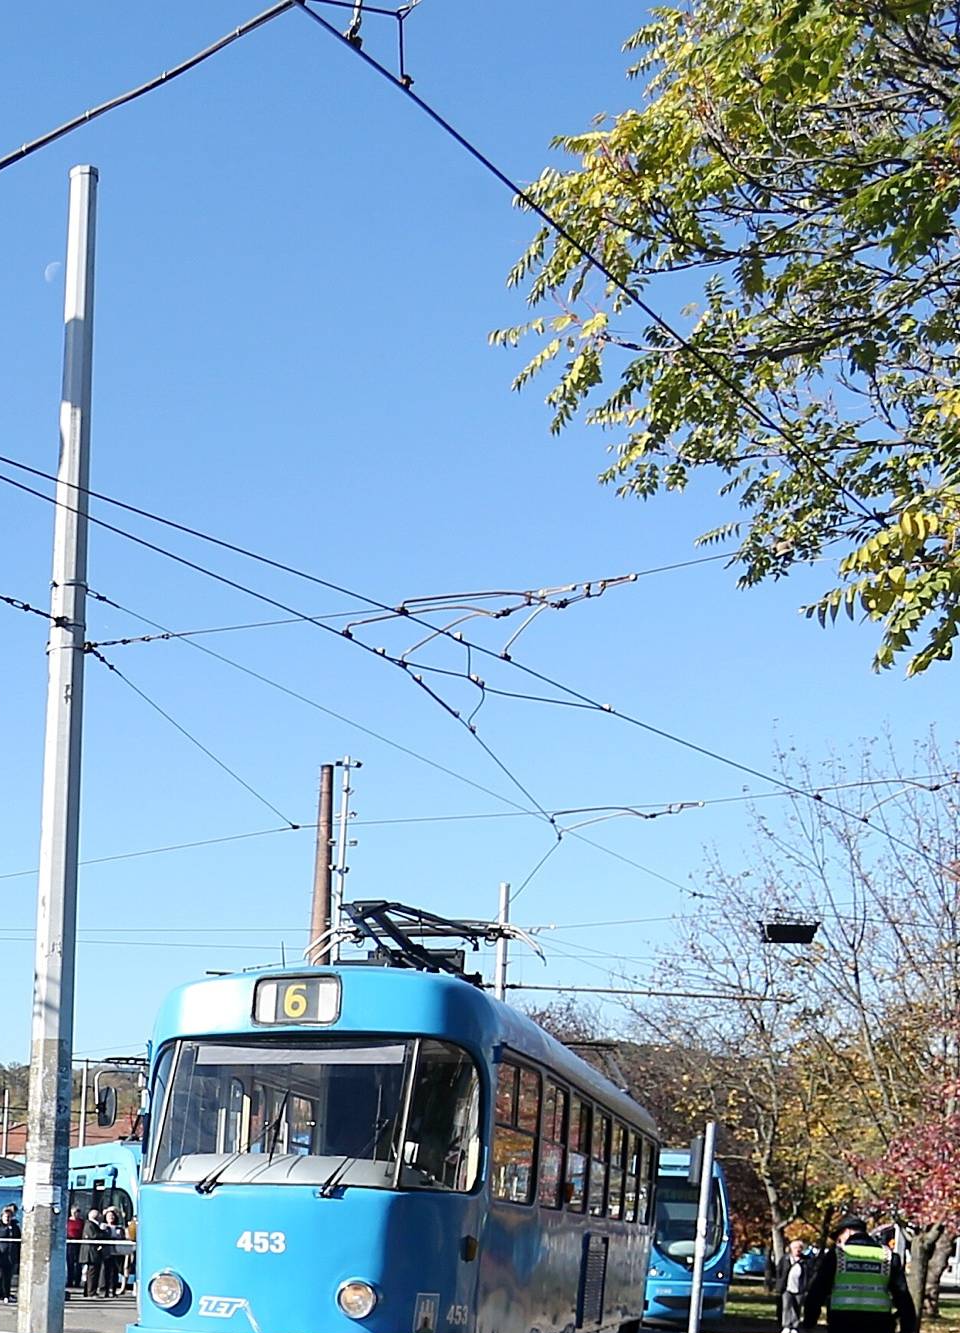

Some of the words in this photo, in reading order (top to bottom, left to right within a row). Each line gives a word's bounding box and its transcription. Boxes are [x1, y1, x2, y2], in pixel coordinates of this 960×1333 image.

[283, 983, 307, 1018] 6
[235, 1231, 286, 1254] 453
[446, 1304, 469, 1325] 453
